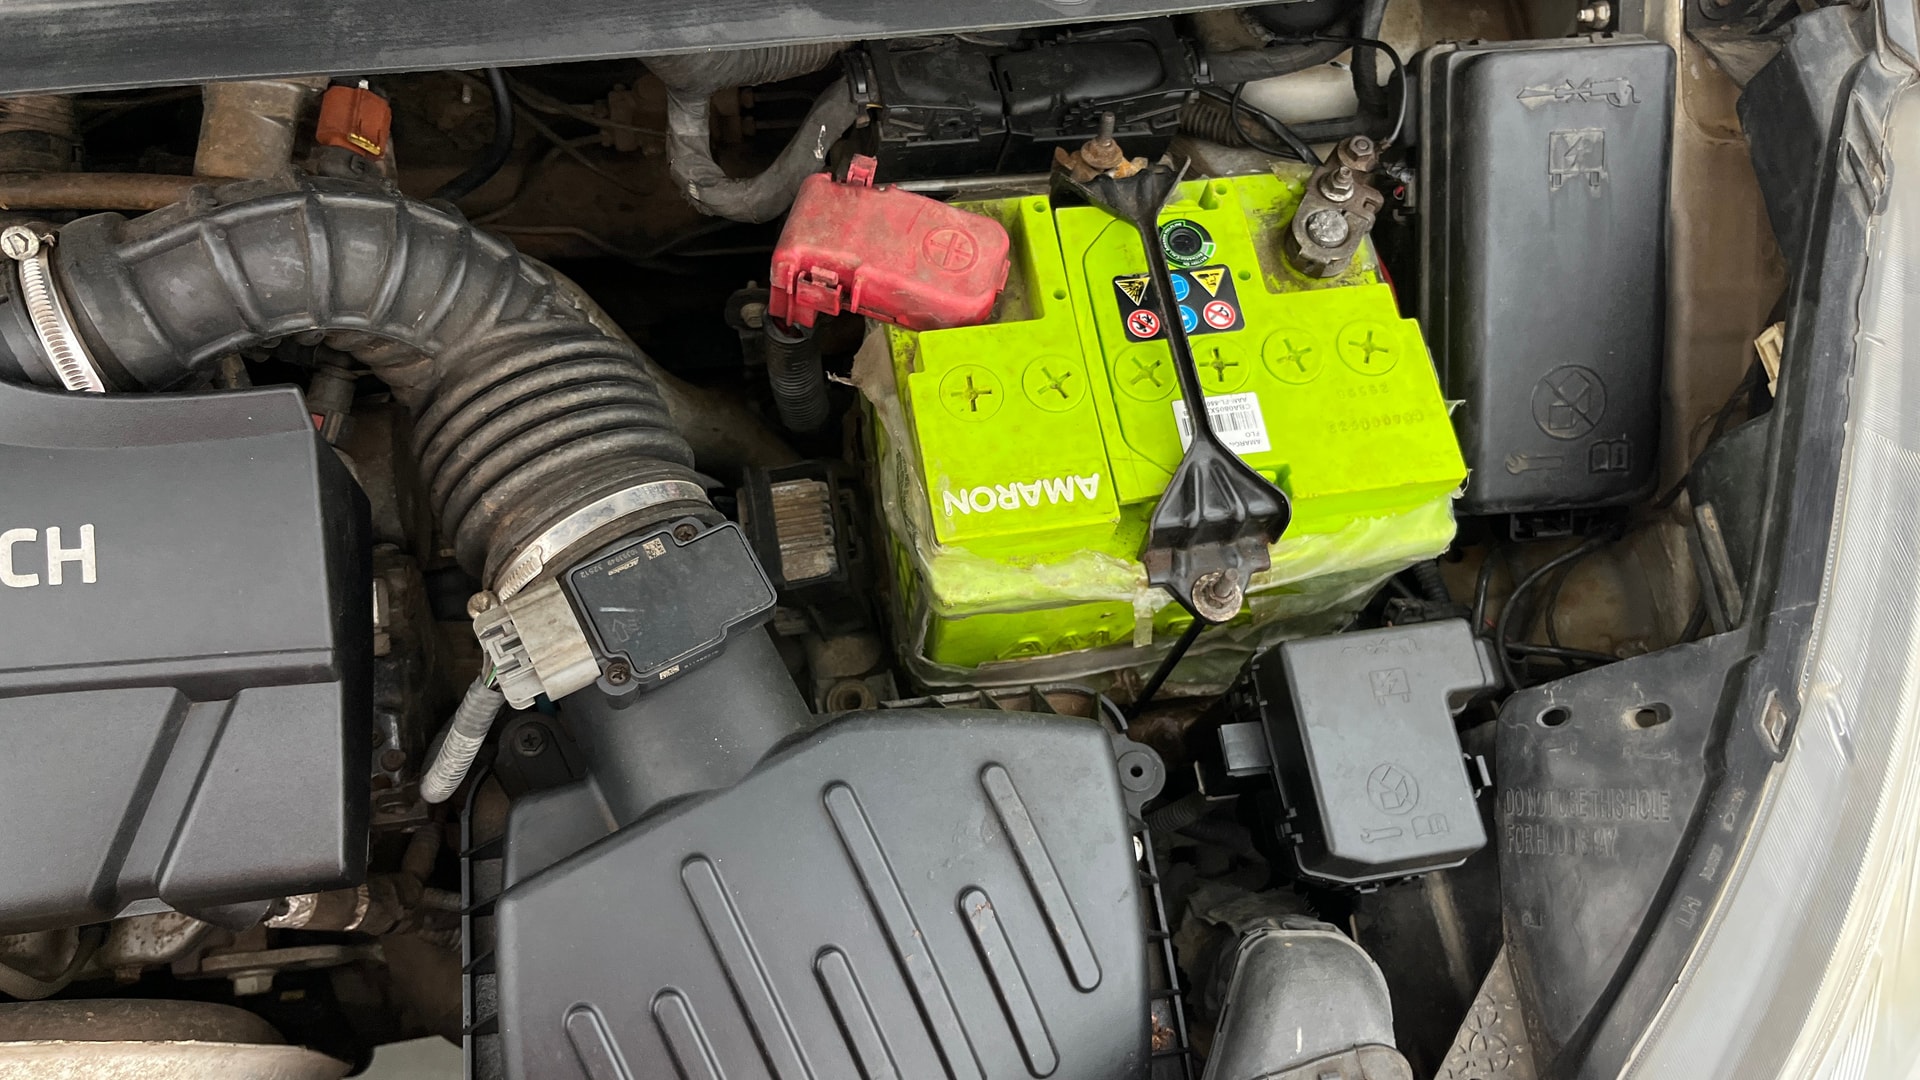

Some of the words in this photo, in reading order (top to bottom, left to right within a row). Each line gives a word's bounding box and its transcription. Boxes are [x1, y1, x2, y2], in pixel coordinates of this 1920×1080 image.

[942, 472, 1100, 517] AMARON
[1505, 786, 1525, 817] DO
[1590, 789, 1626, 821] THIS
[1628, 790, 1672, 823] HOLE
[1506, 823, 1534, 855] FOR
